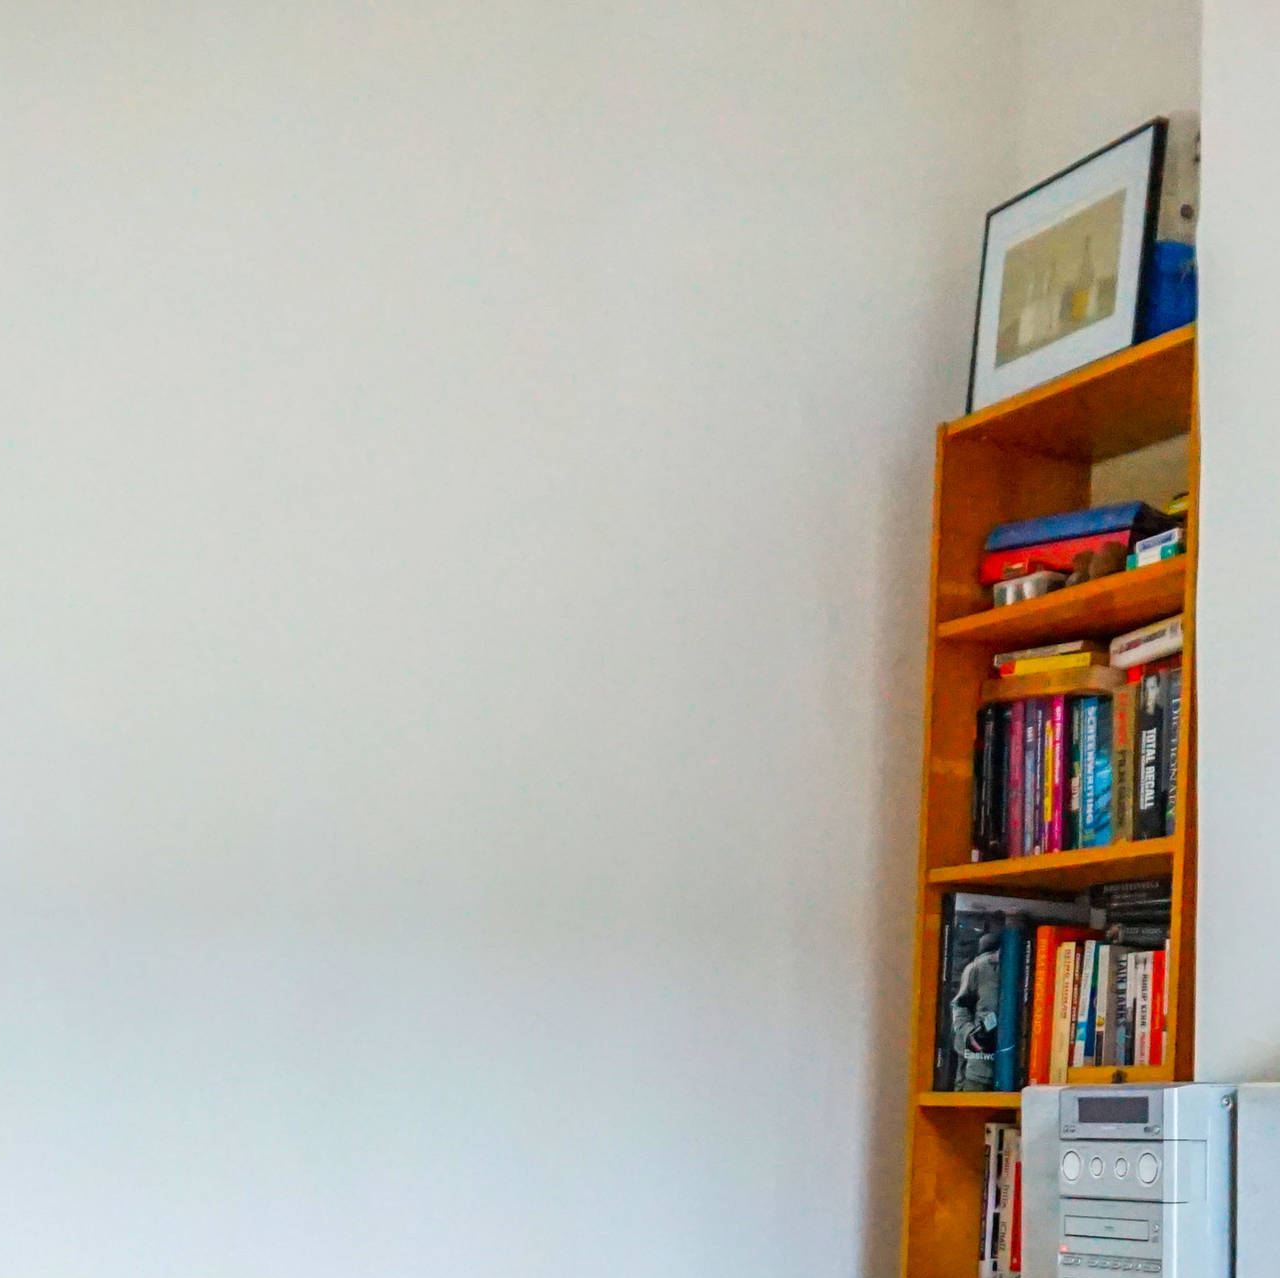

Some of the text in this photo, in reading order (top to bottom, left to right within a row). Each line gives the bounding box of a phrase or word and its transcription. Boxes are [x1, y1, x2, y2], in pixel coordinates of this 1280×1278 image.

[1085, 705, 1098, 824] SCREENWRITING
[1144, 727, 1157, 809] TOTAL RECALL
